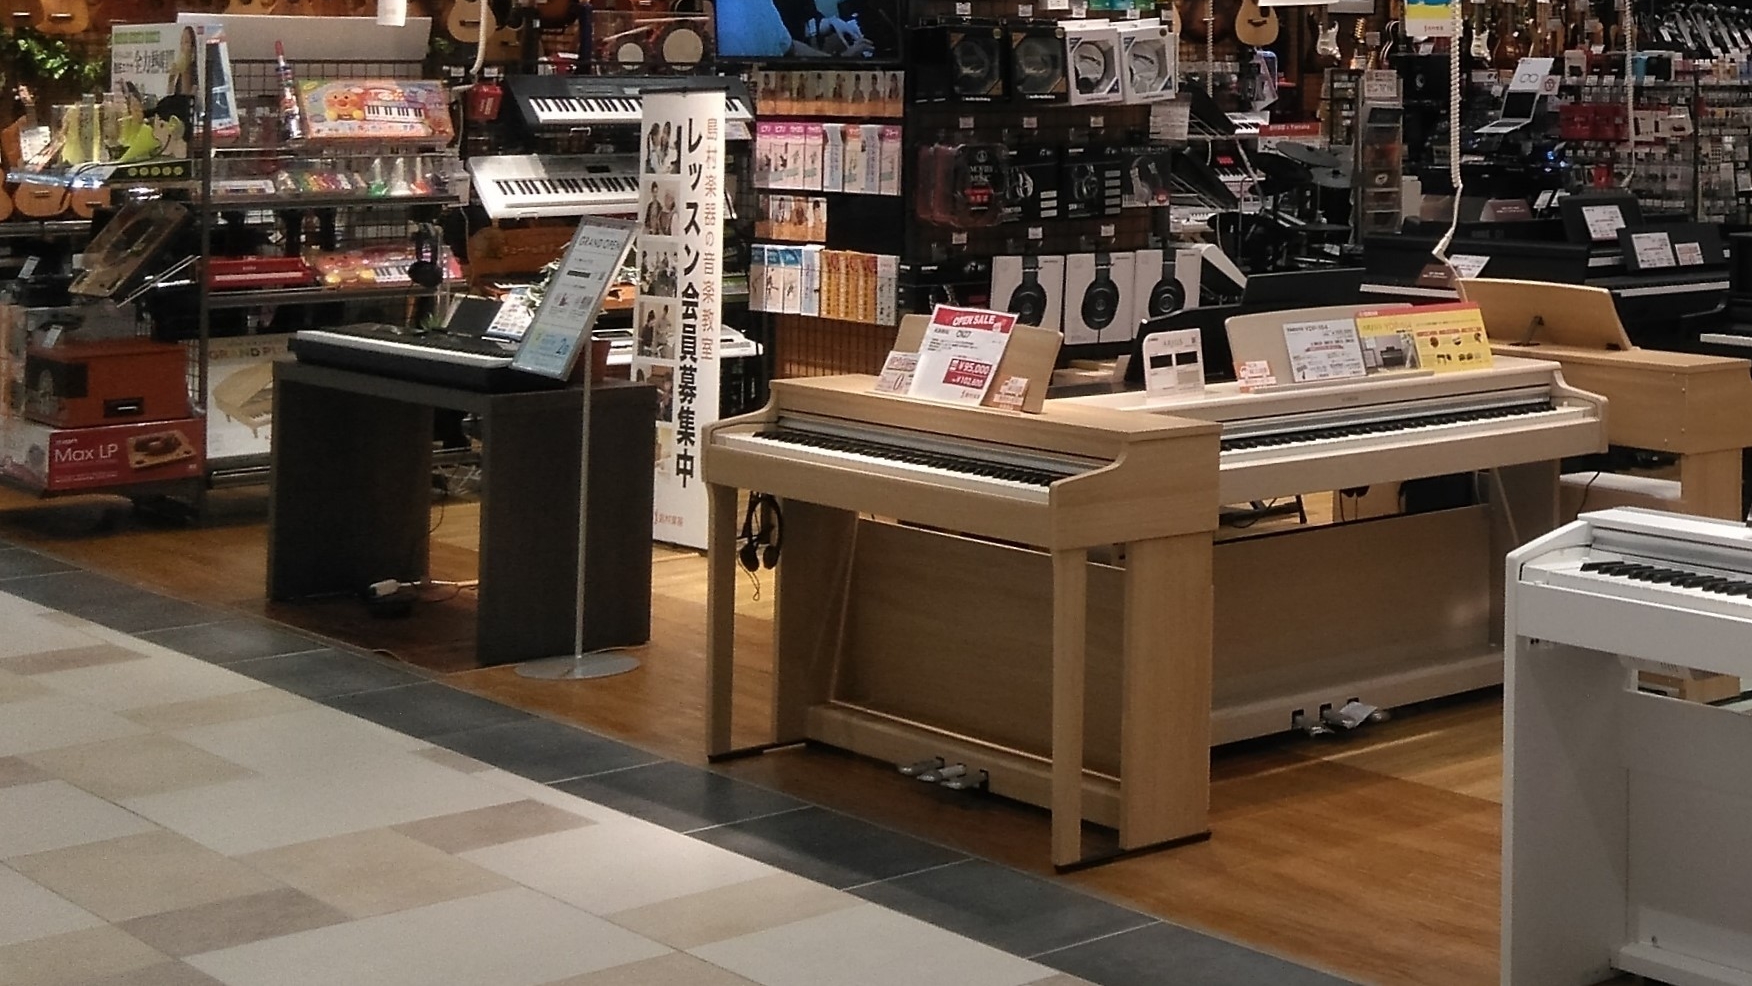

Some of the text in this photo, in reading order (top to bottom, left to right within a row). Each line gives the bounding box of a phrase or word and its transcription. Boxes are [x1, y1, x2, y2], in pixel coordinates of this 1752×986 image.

[579, 236, 603, 249] GRAND
[701, 118, 718, 361] 島村楽器の音楽教室
[674, 118, 702, 489] レッスン会員募集中
[952, 315, 996, 326] OPEN SALE
[959, 361, 990, 375] ¥95,000
[54, 444, 118, 462] Max LP
